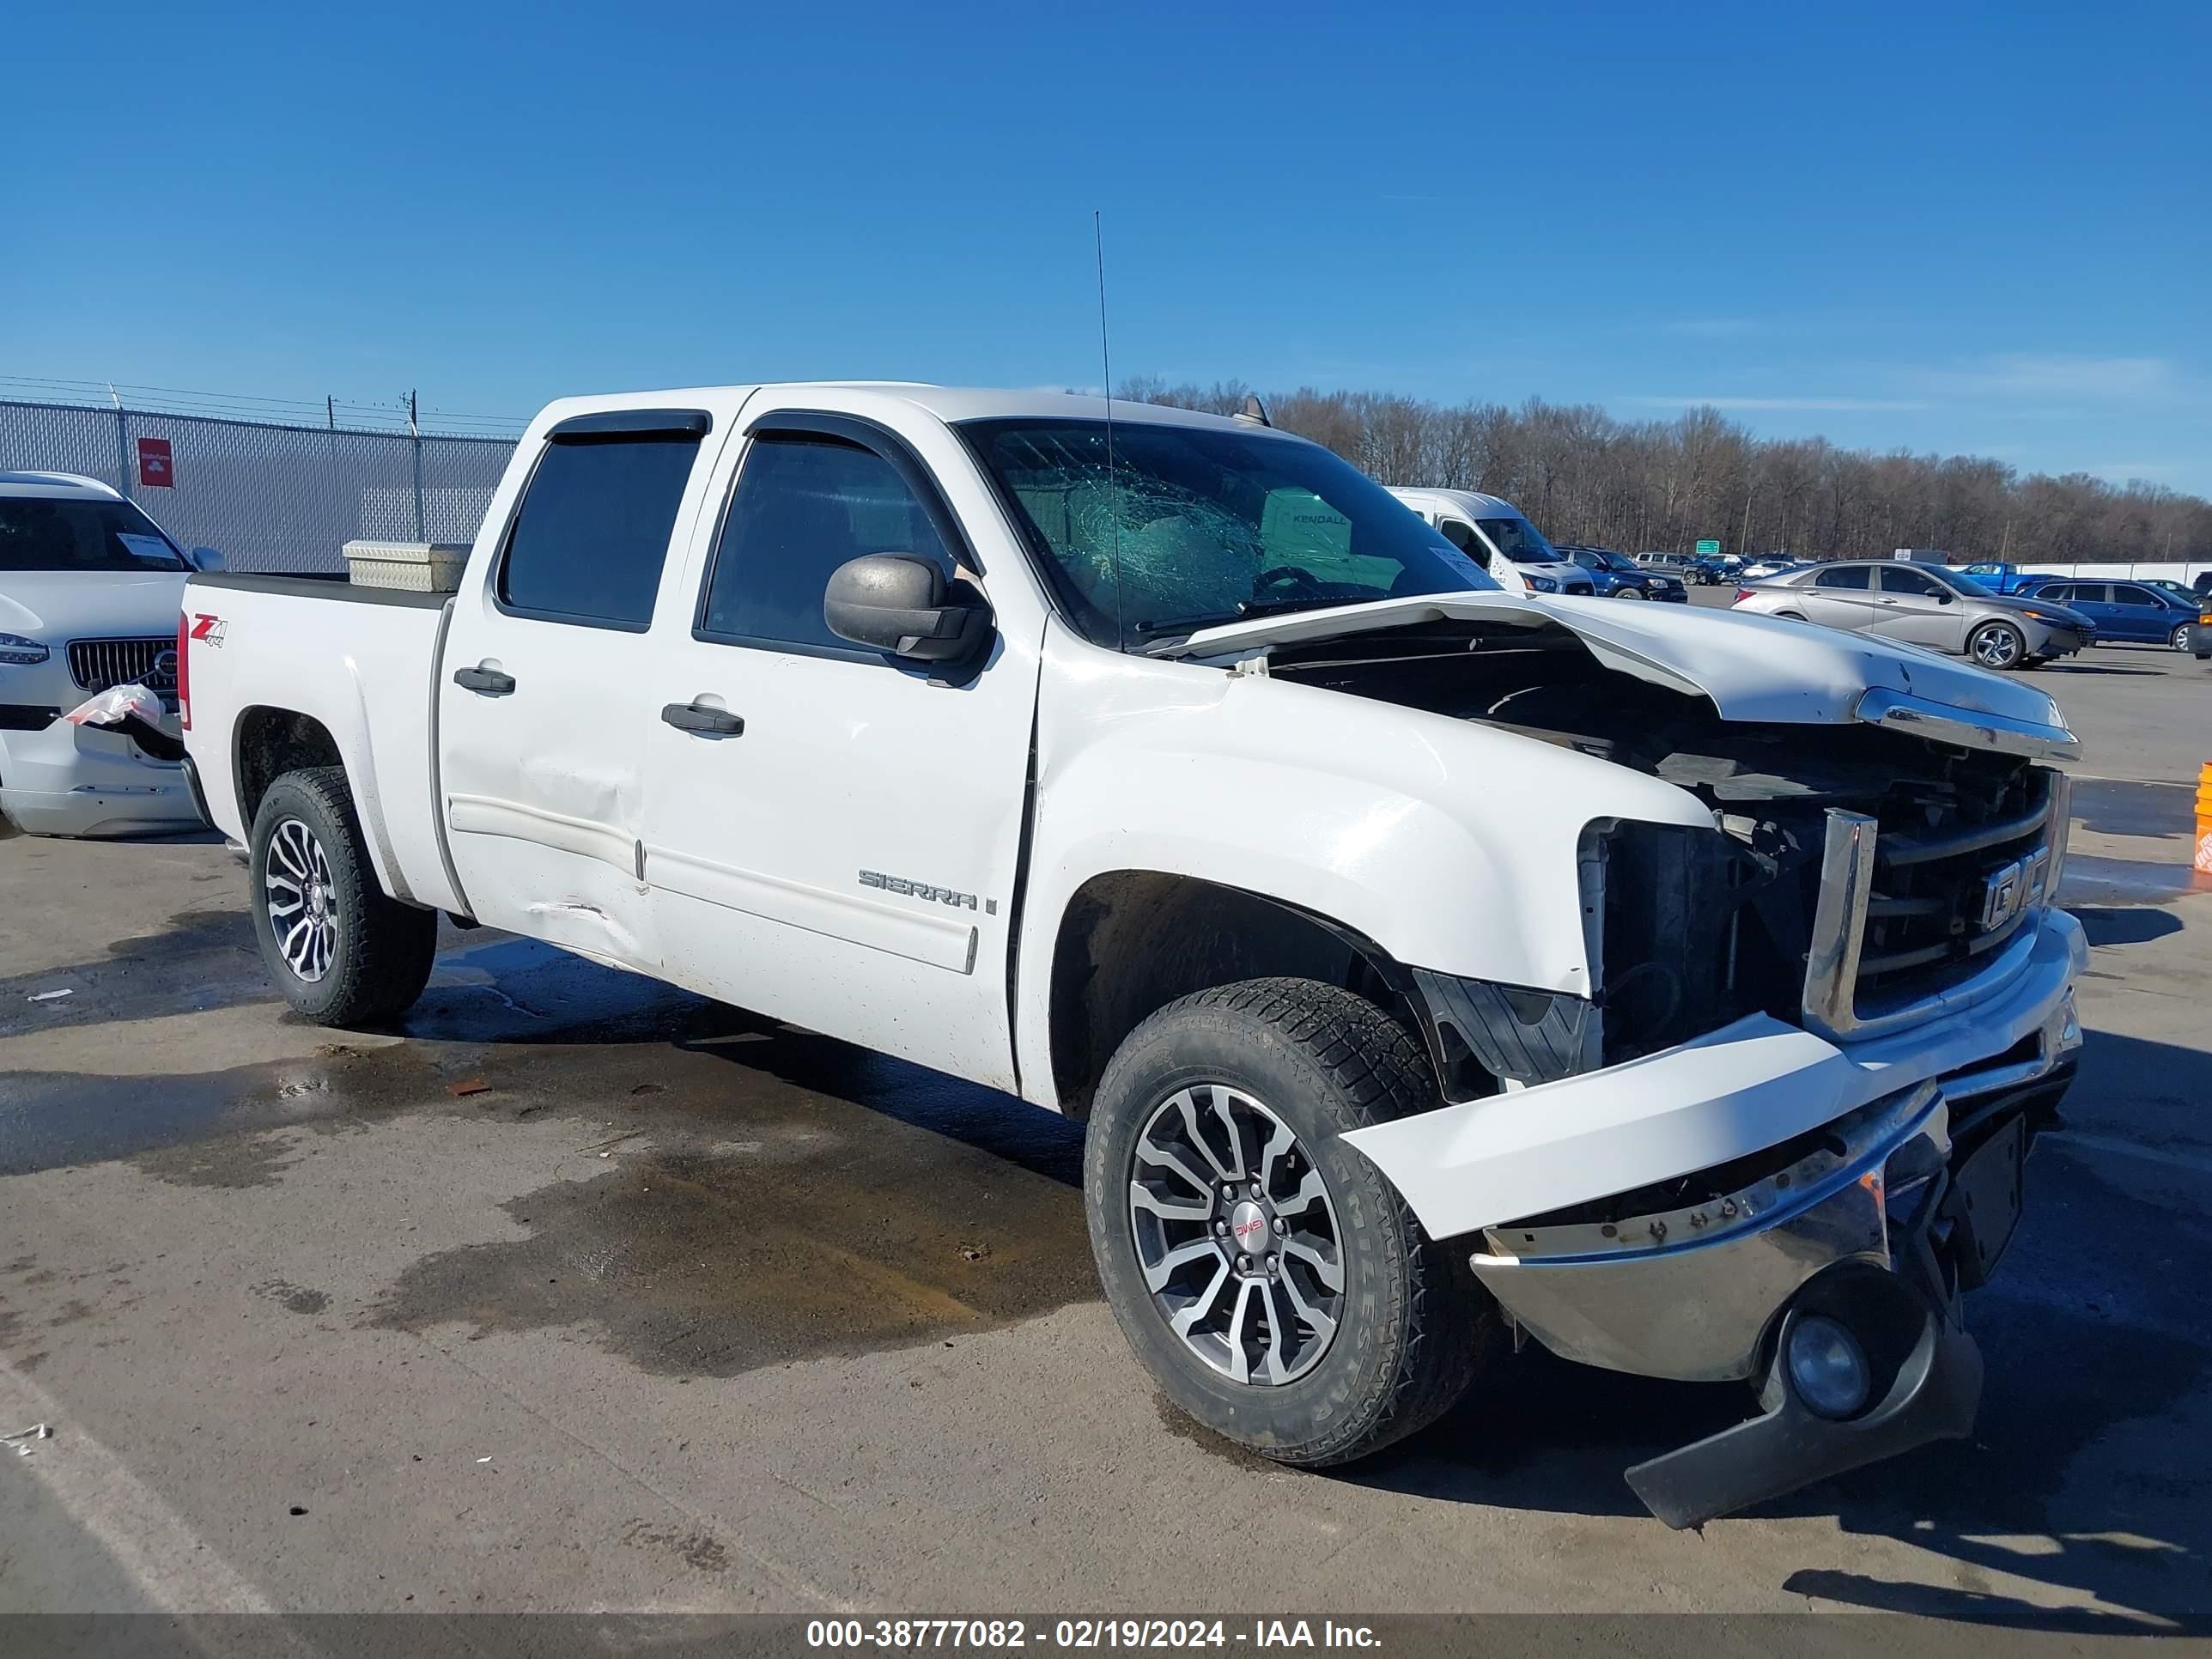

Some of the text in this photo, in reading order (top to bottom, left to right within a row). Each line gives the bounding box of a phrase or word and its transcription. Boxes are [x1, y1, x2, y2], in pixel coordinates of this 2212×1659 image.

[1293, 514, 1347, 526] KENDALL
[191, 613, 228, 640] Z71
[858, 868, 978, 911] SIERRA
[1982, 846, 2048, 932] GMC
[1235, 1218, 1264, 1237] GMC
